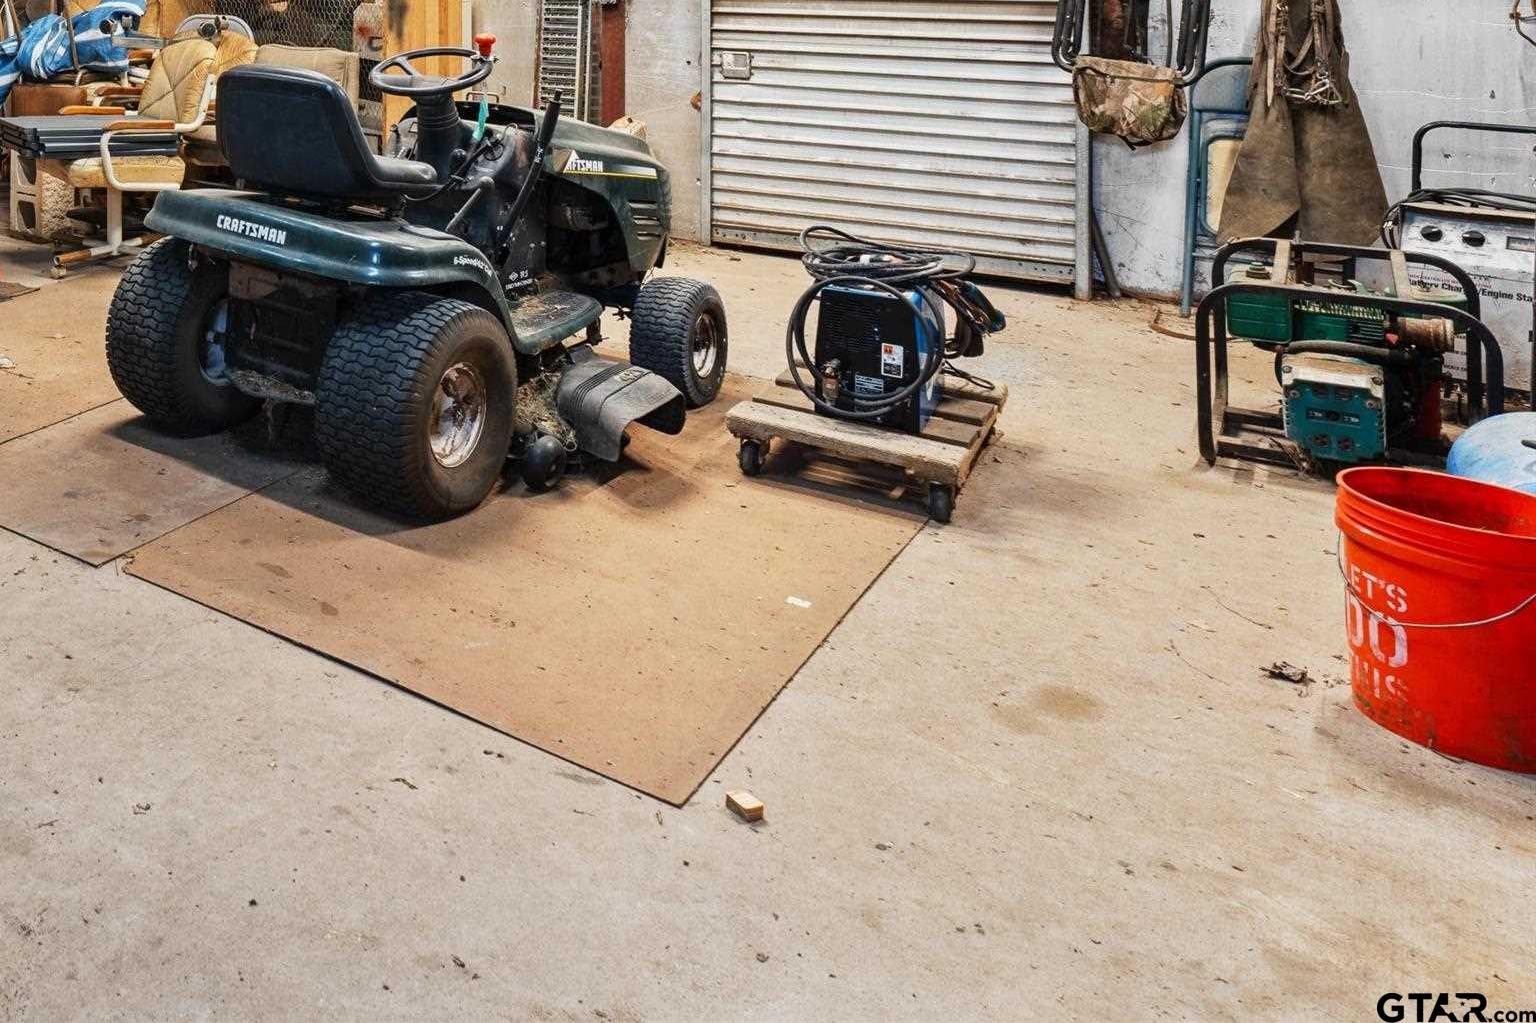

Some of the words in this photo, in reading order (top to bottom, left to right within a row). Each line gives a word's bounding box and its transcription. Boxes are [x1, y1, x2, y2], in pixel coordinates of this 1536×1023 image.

[216, 214, 287, 245] CRAFTSMAN
[1515, 292, 1533, 303] Sta
[1345, 590, 1409, 668] DO
